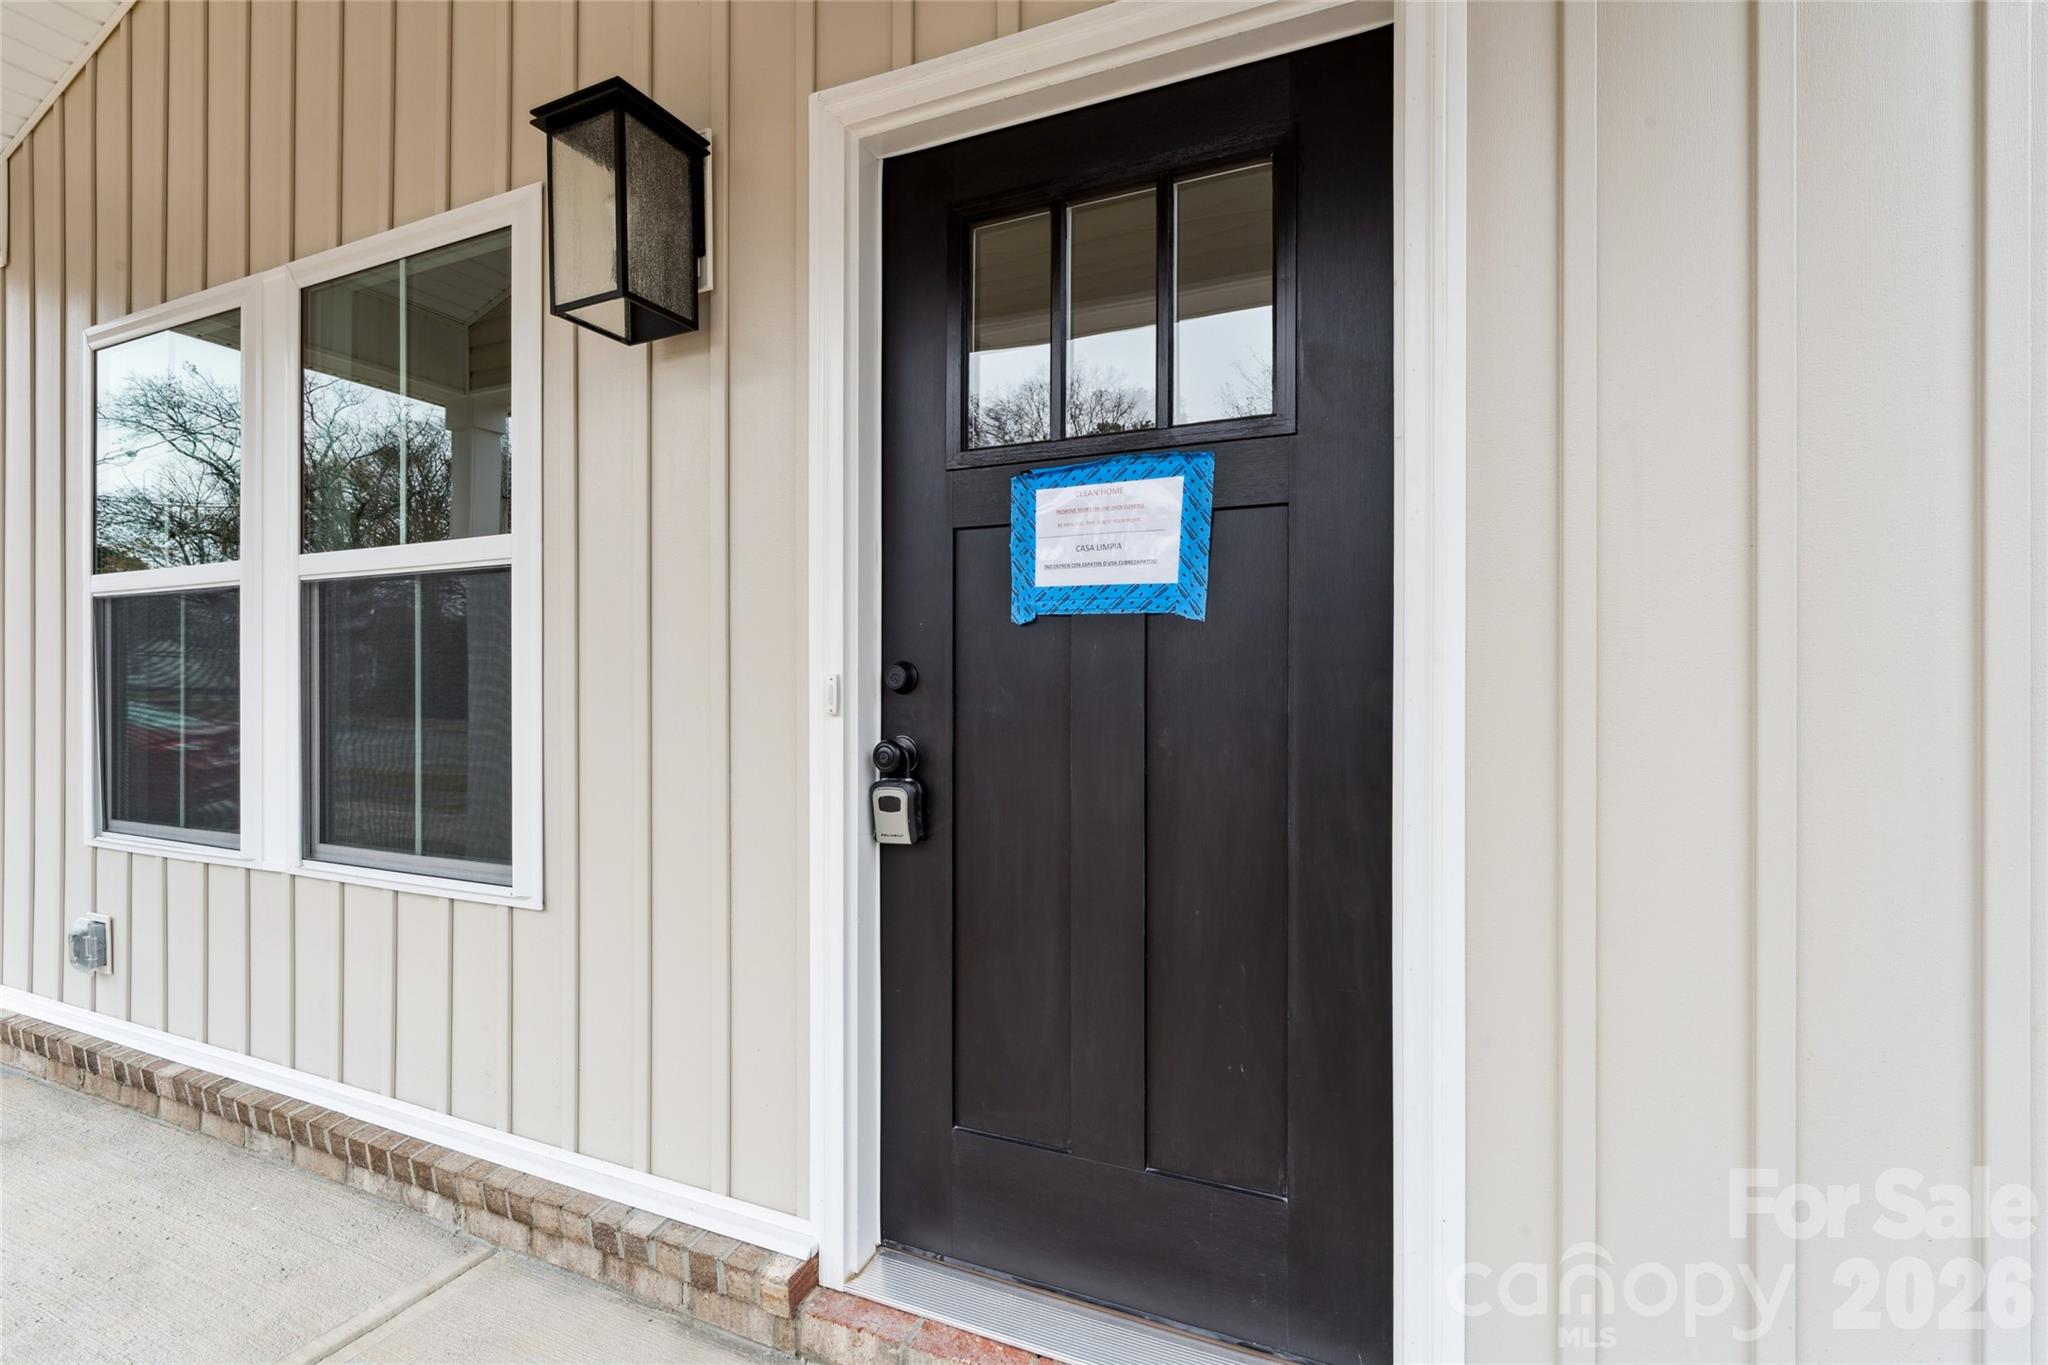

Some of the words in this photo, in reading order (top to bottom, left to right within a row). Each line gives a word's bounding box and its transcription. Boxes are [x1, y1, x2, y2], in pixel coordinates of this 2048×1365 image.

[1075, 488, 1099, 498] CLEAN
[1100, 486, 1124, 496] HOME
[1075, 544, 1095, 552] CASA
[1096, 542, 1122, 551] LIMPIA
